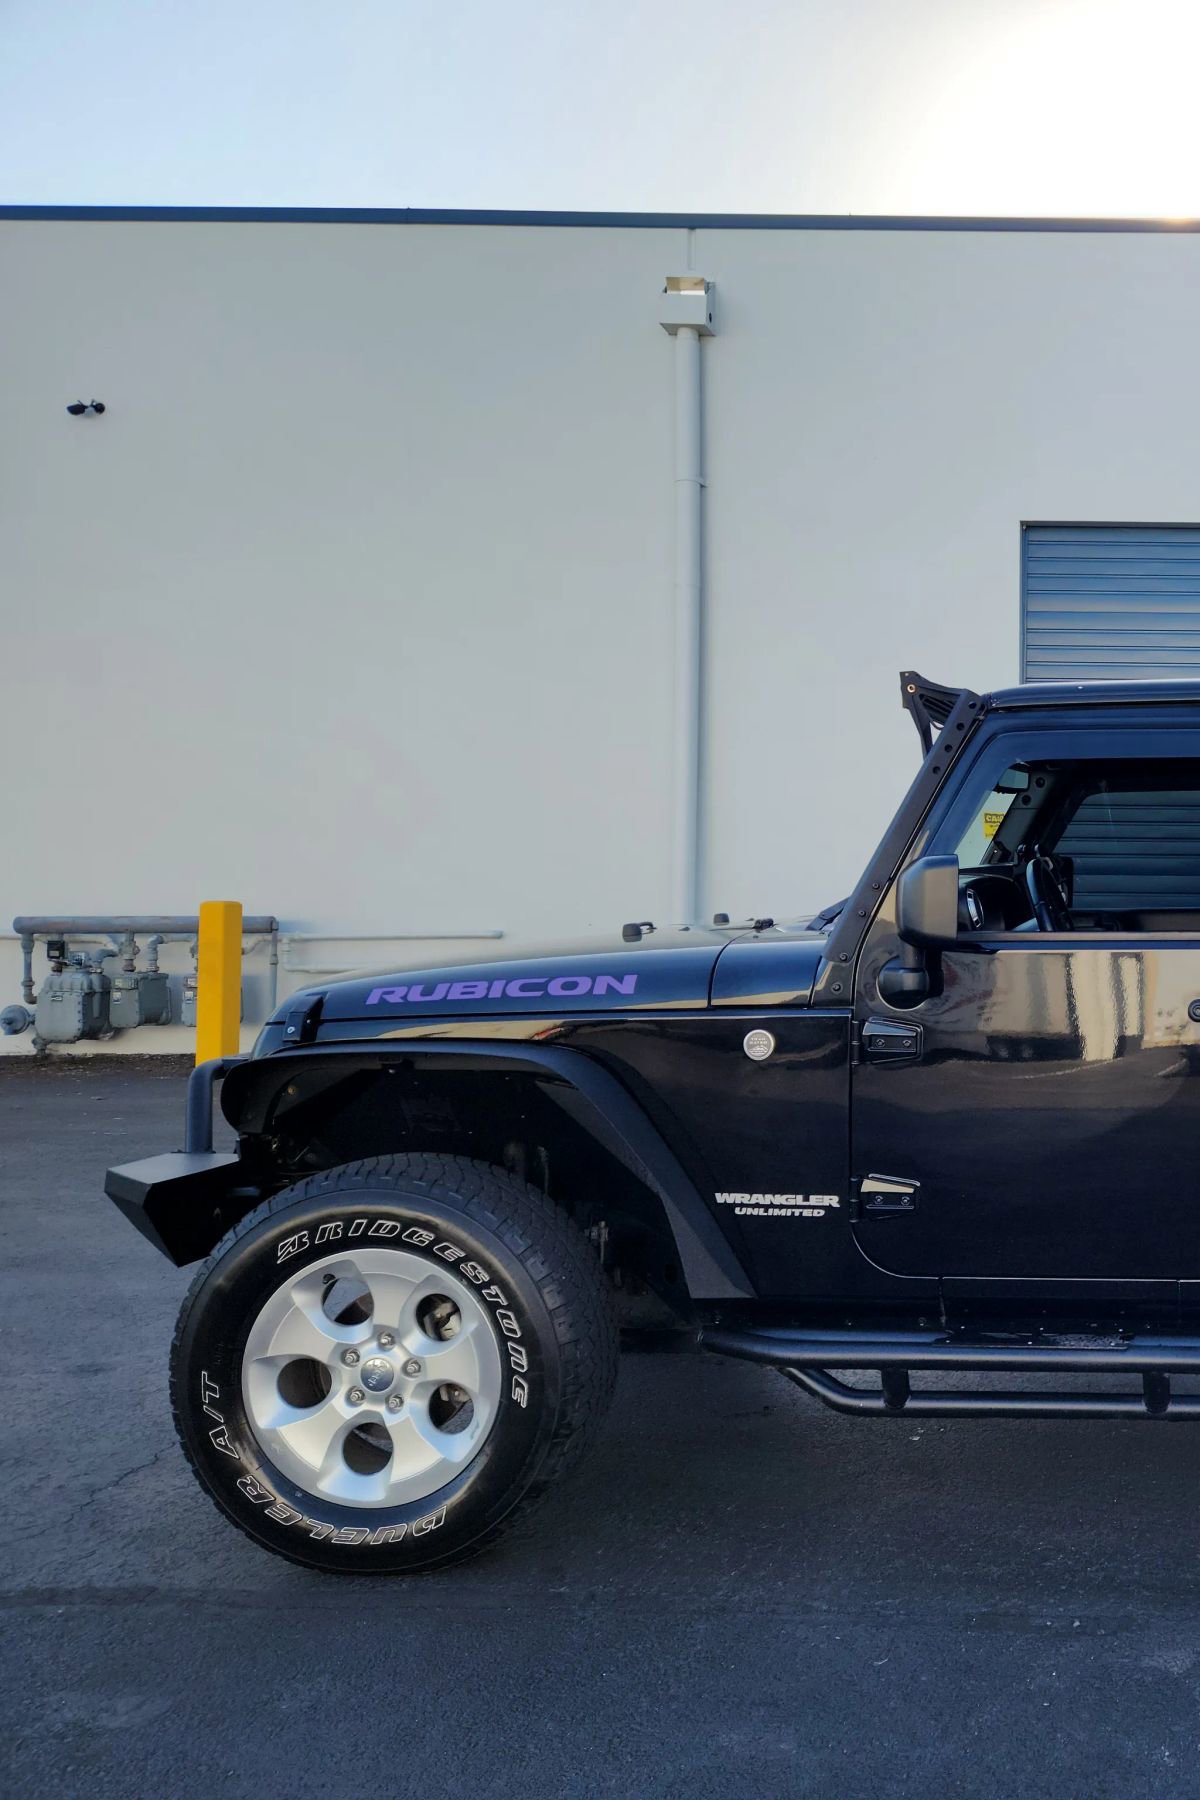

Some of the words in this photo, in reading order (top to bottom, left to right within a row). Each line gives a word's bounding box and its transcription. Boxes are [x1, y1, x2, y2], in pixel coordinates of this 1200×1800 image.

[365, 974, 638, 1005] RUBICON
[714, 1192, 840, 1208] WRANGLER
[734, 1206, 826, 1217] UNLIMITED
[277, 1218, 530, 1409] BRIDGESTONE
[202, 1371, 239, 1459] A/T
[236, 1473, 448, 1545] DUELER
